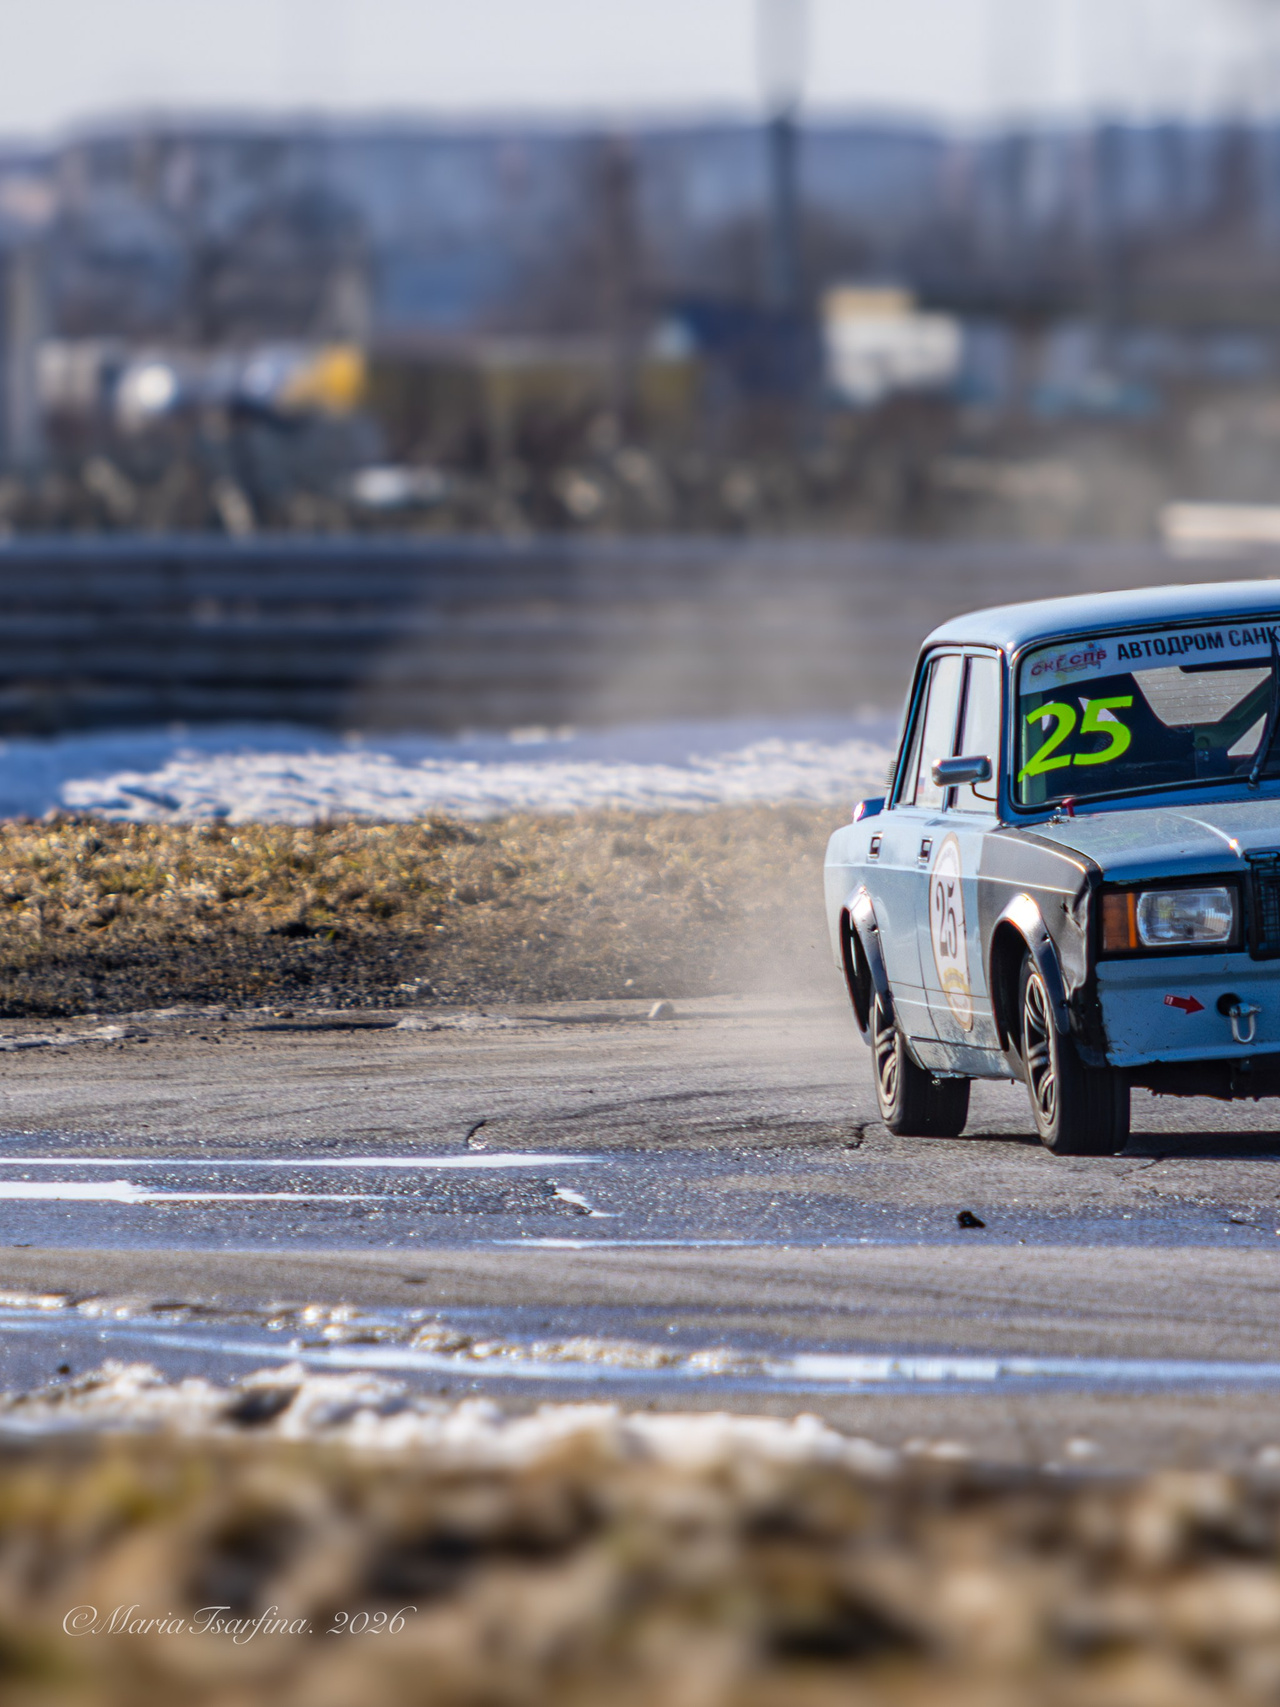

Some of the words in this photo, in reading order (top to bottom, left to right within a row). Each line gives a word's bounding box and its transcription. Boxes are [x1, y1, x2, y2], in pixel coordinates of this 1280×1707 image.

[1117, 631, 1225, 661] АВТОДРОМ
[1017, 695, 1133, 783] 25
[936, 881, 958, 959] 25
